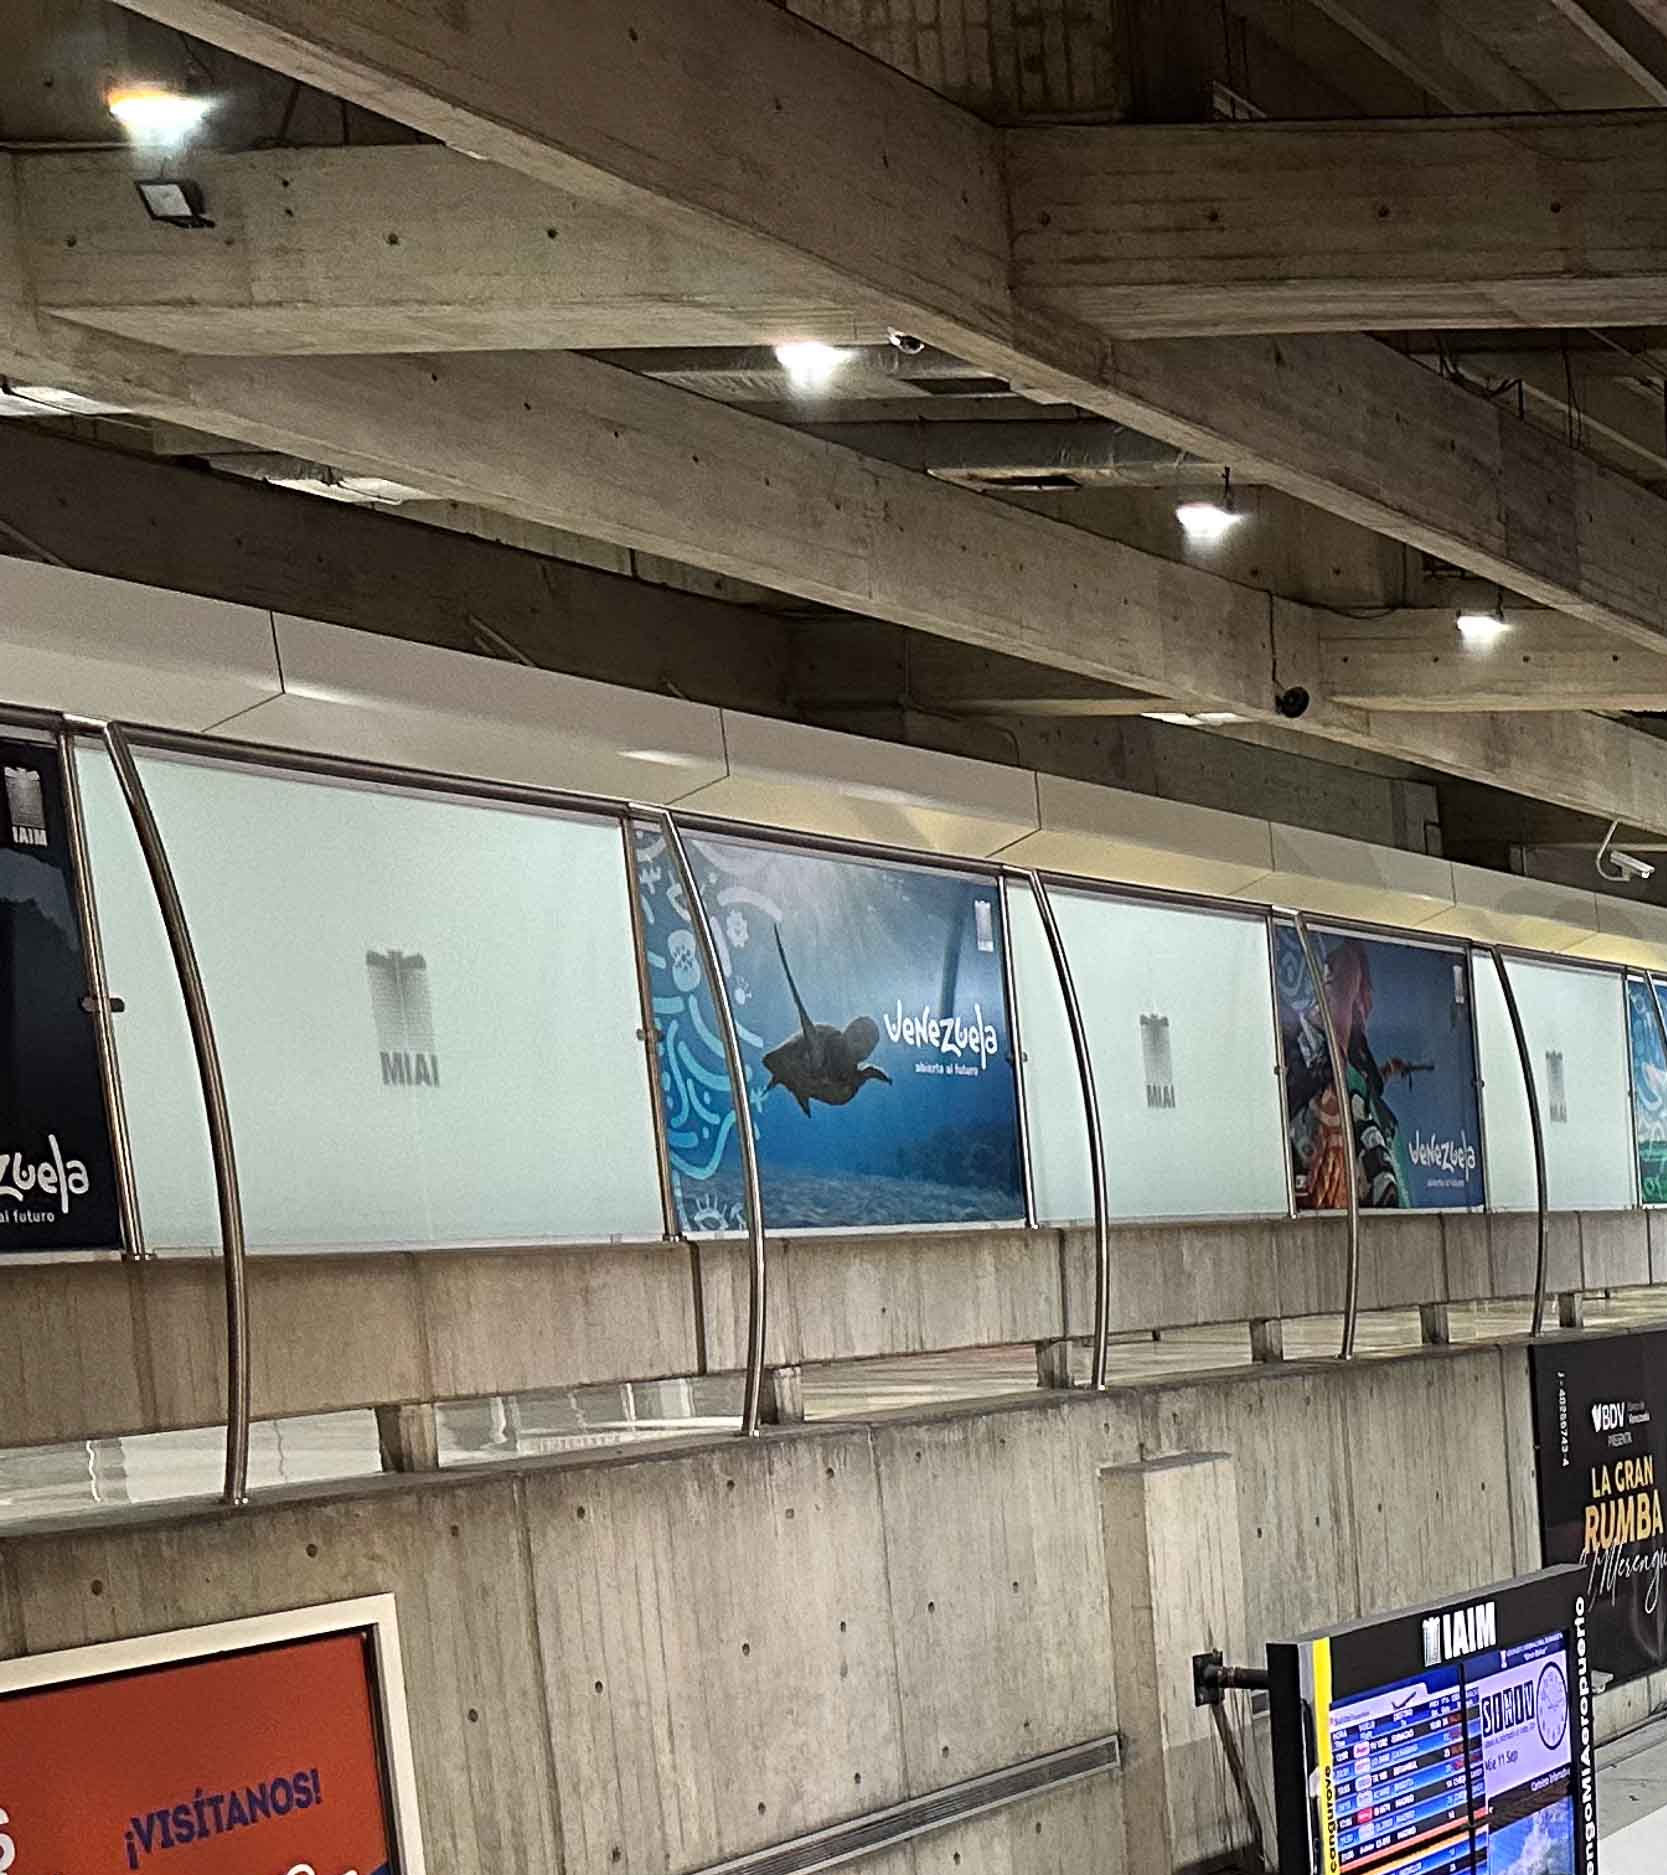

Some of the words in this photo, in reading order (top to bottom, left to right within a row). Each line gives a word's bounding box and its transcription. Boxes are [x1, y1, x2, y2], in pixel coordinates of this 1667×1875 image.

[15, 1210, 55, 1223] futuro
[1602, 1402, 1625, 1429] BDV
[1591, 1465, 1612, 1498] LA
[1615, 1454, 1654, 1493] GRAN
[1584, 1489, 1664, 1554] RUMBA
[1442, 1601, 1496, 1660] IAIM
[125, 1768, 322, 1870] ¡VISÍTANOS!
